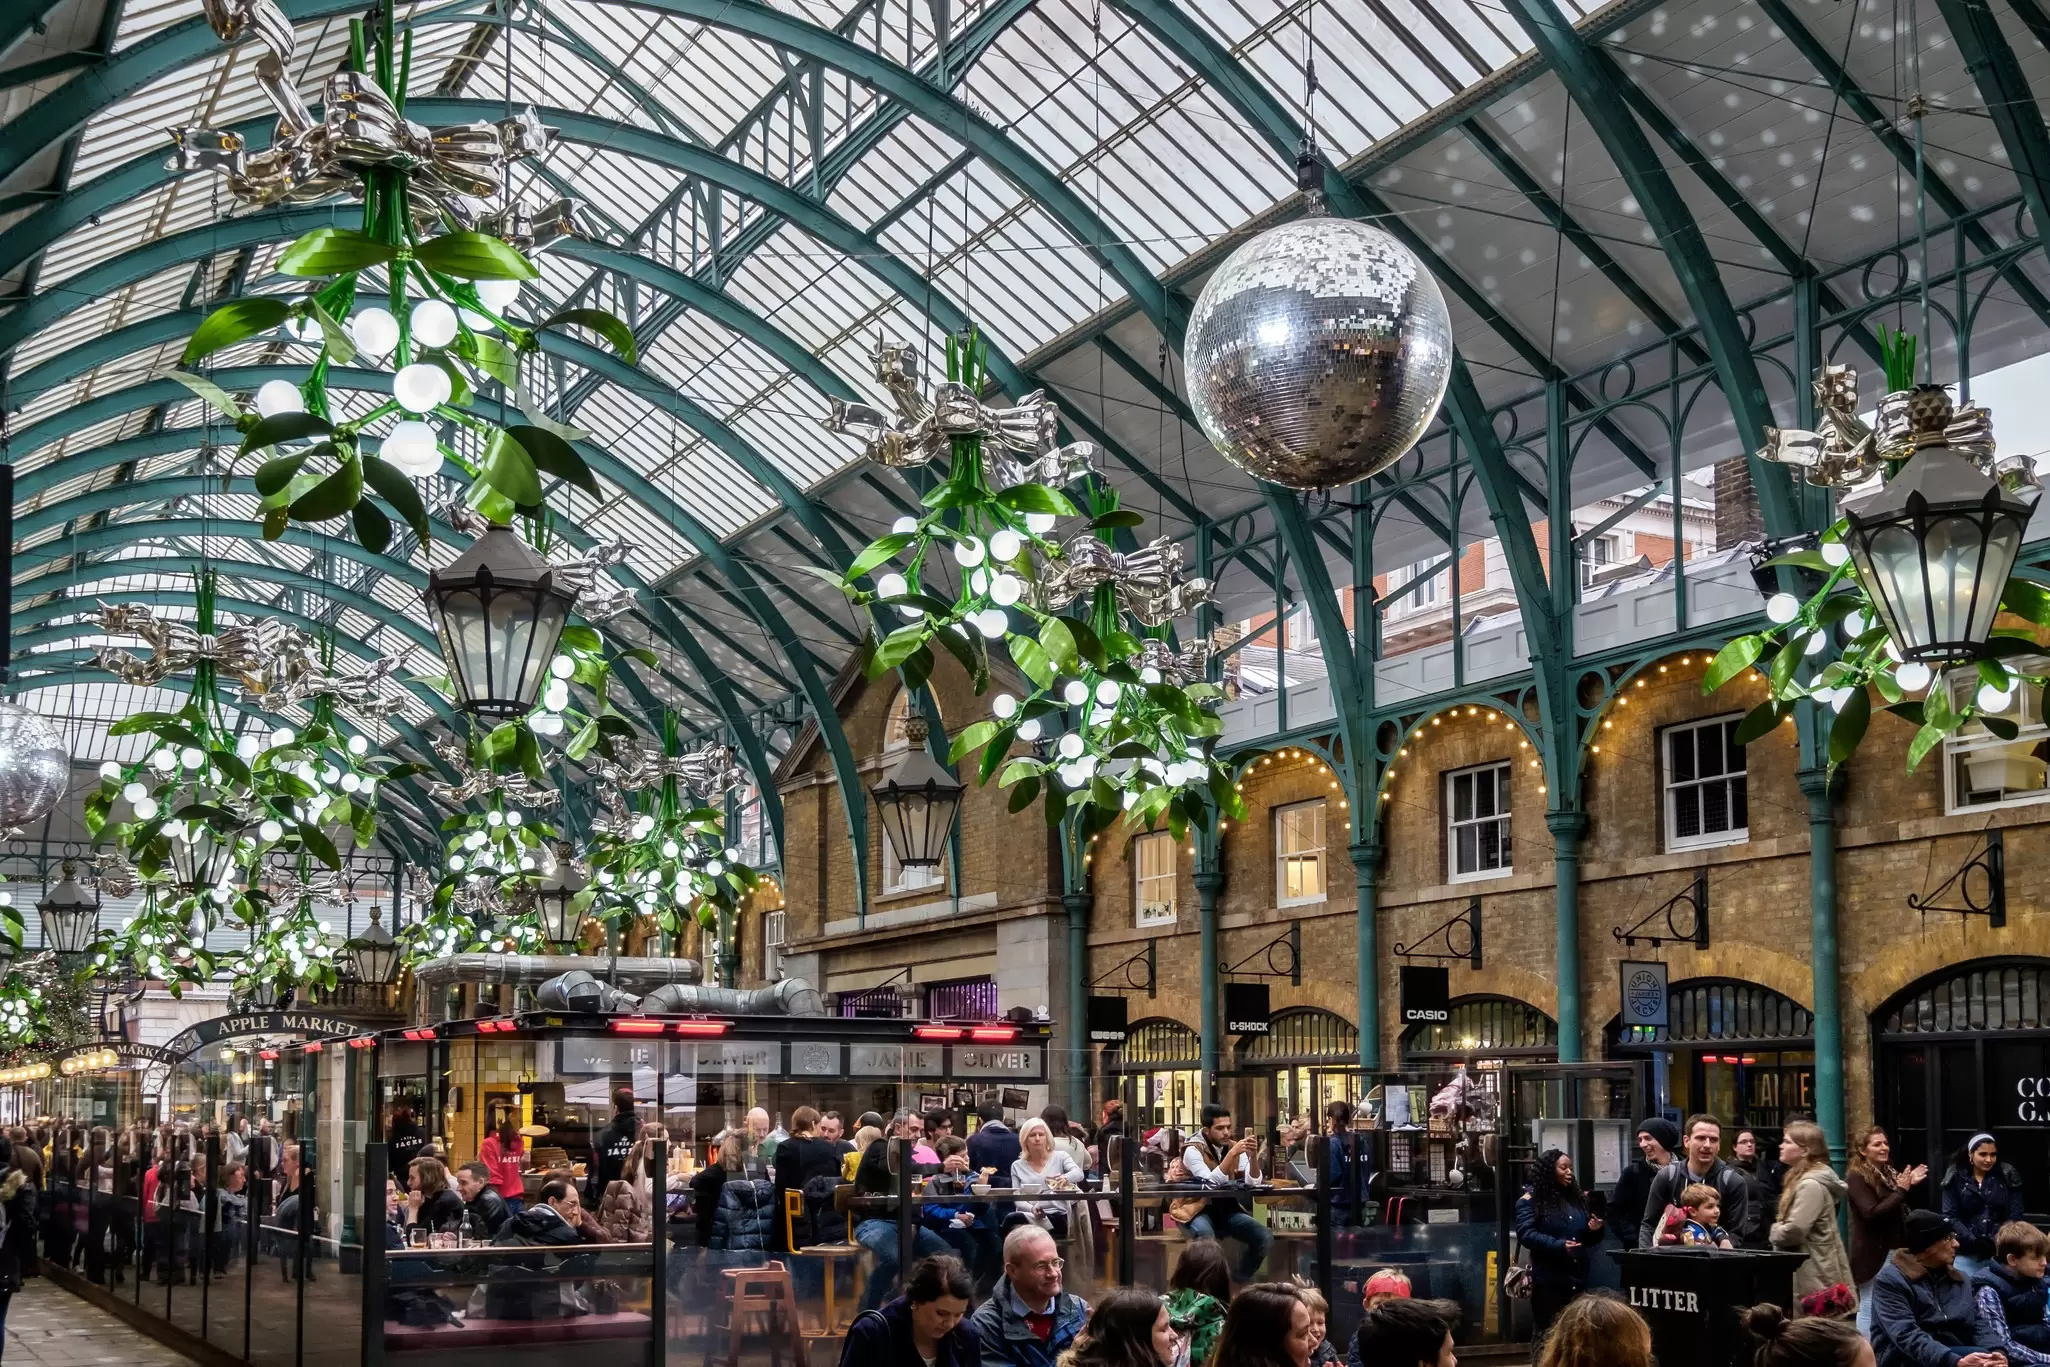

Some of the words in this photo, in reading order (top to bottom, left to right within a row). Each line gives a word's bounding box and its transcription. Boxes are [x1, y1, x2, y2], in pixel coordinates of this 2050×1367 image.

[1631, 973, 1657, 989] UNION
[1406, 1009, 1448, 1020] CASIO
[218, 1015, 270, 1035] APPLE
[282, 1014, 358, 1036] MARKET
[1229, 1021, 1269, 1032] G-SHOCK
[866, 1051, 927, 1068] JAMIE
[963, 1052, 1030, 1069] OLIVER
[1748, 1072, 1811, 1107] JAMIE
[1629, 1286, 1699, 1313] LITTER
